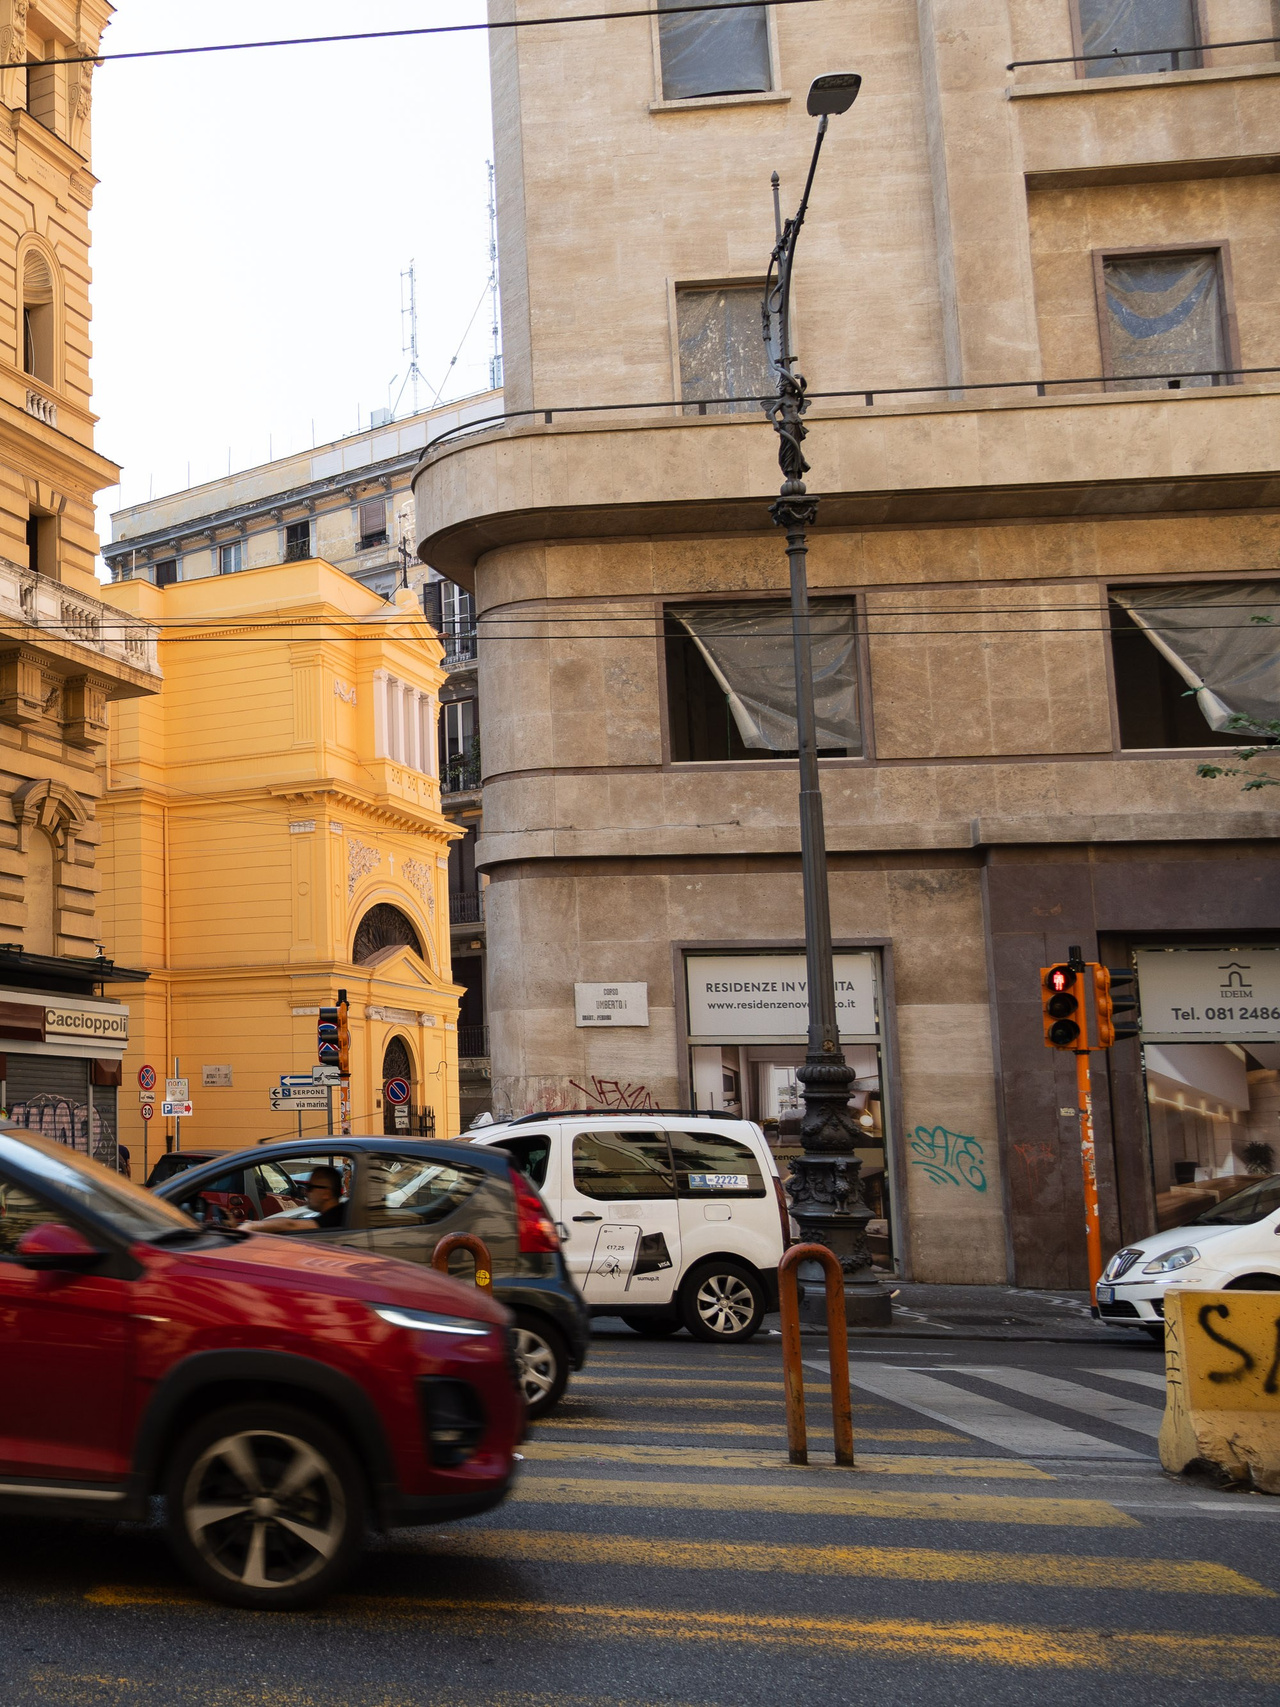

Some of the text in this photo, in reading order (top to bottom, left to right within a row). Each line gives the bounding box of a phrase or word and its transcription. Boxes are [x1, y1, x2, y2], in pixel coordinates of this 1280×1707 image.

[706, 982, 777, 993] RESIDENZE
[781, 982, 795, 992] IN
[1220, 990, 1253, 998] IDEIM
[596, 1000, 623, 1009] UMBERTO
[1171, 1007, 1280, 1020] Tel. 081 2486
[45, 1009, 127, 1033] Caccioppoli
[143, 1107, 151, 1116] 30
[714, 1175, 739, 1185] 2222
